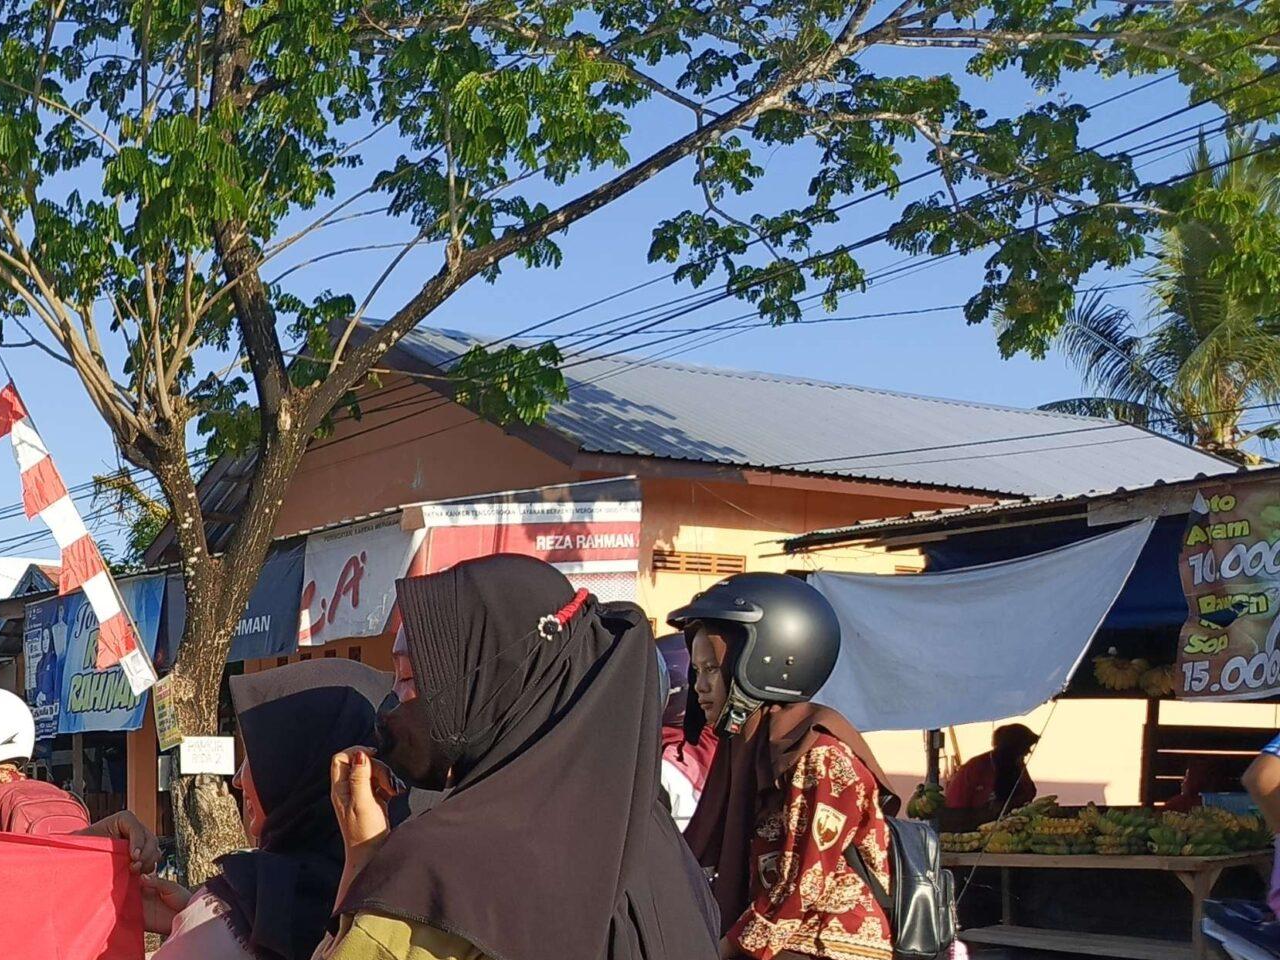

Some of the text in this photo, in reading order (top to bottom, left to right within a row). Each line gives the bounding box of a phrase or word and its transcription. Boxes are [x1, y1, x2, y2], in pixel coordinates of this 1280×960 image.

[536, 533, 634, 550] REZA RAHMAN
[1184, 633, 1229, 655] Sop
